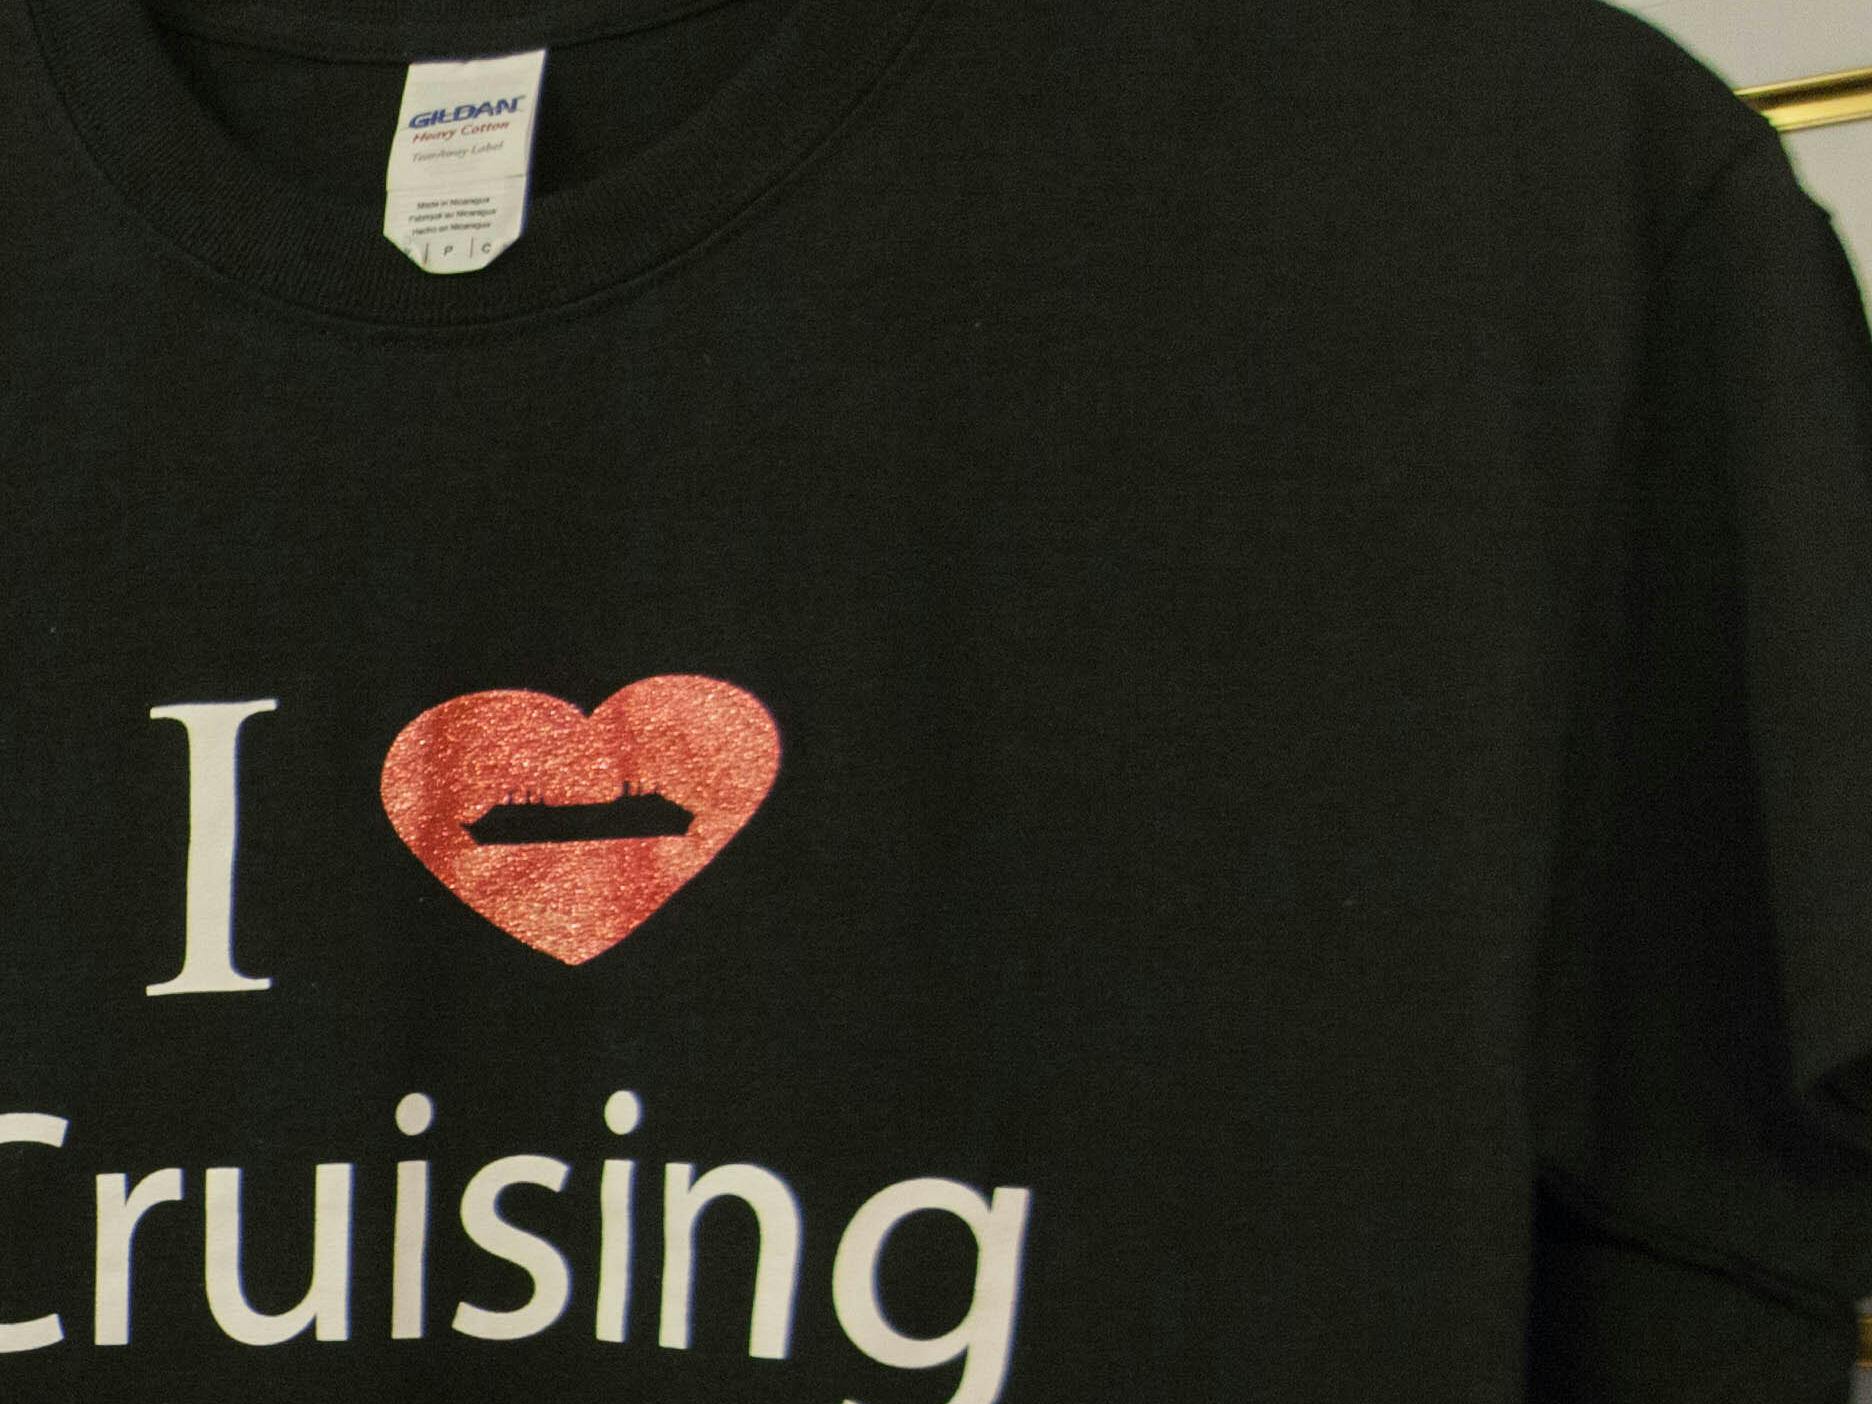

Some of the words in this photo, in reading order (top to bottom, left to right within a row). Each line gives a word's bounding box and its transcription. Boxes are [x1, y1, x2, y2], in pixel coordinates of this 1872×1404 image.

[409, 96, 522, 129] GILDAN
[412, 126, 457, 145] Heavy
[461, 121, 510, 136] Cotton
[146, 698, 277, 997] I
